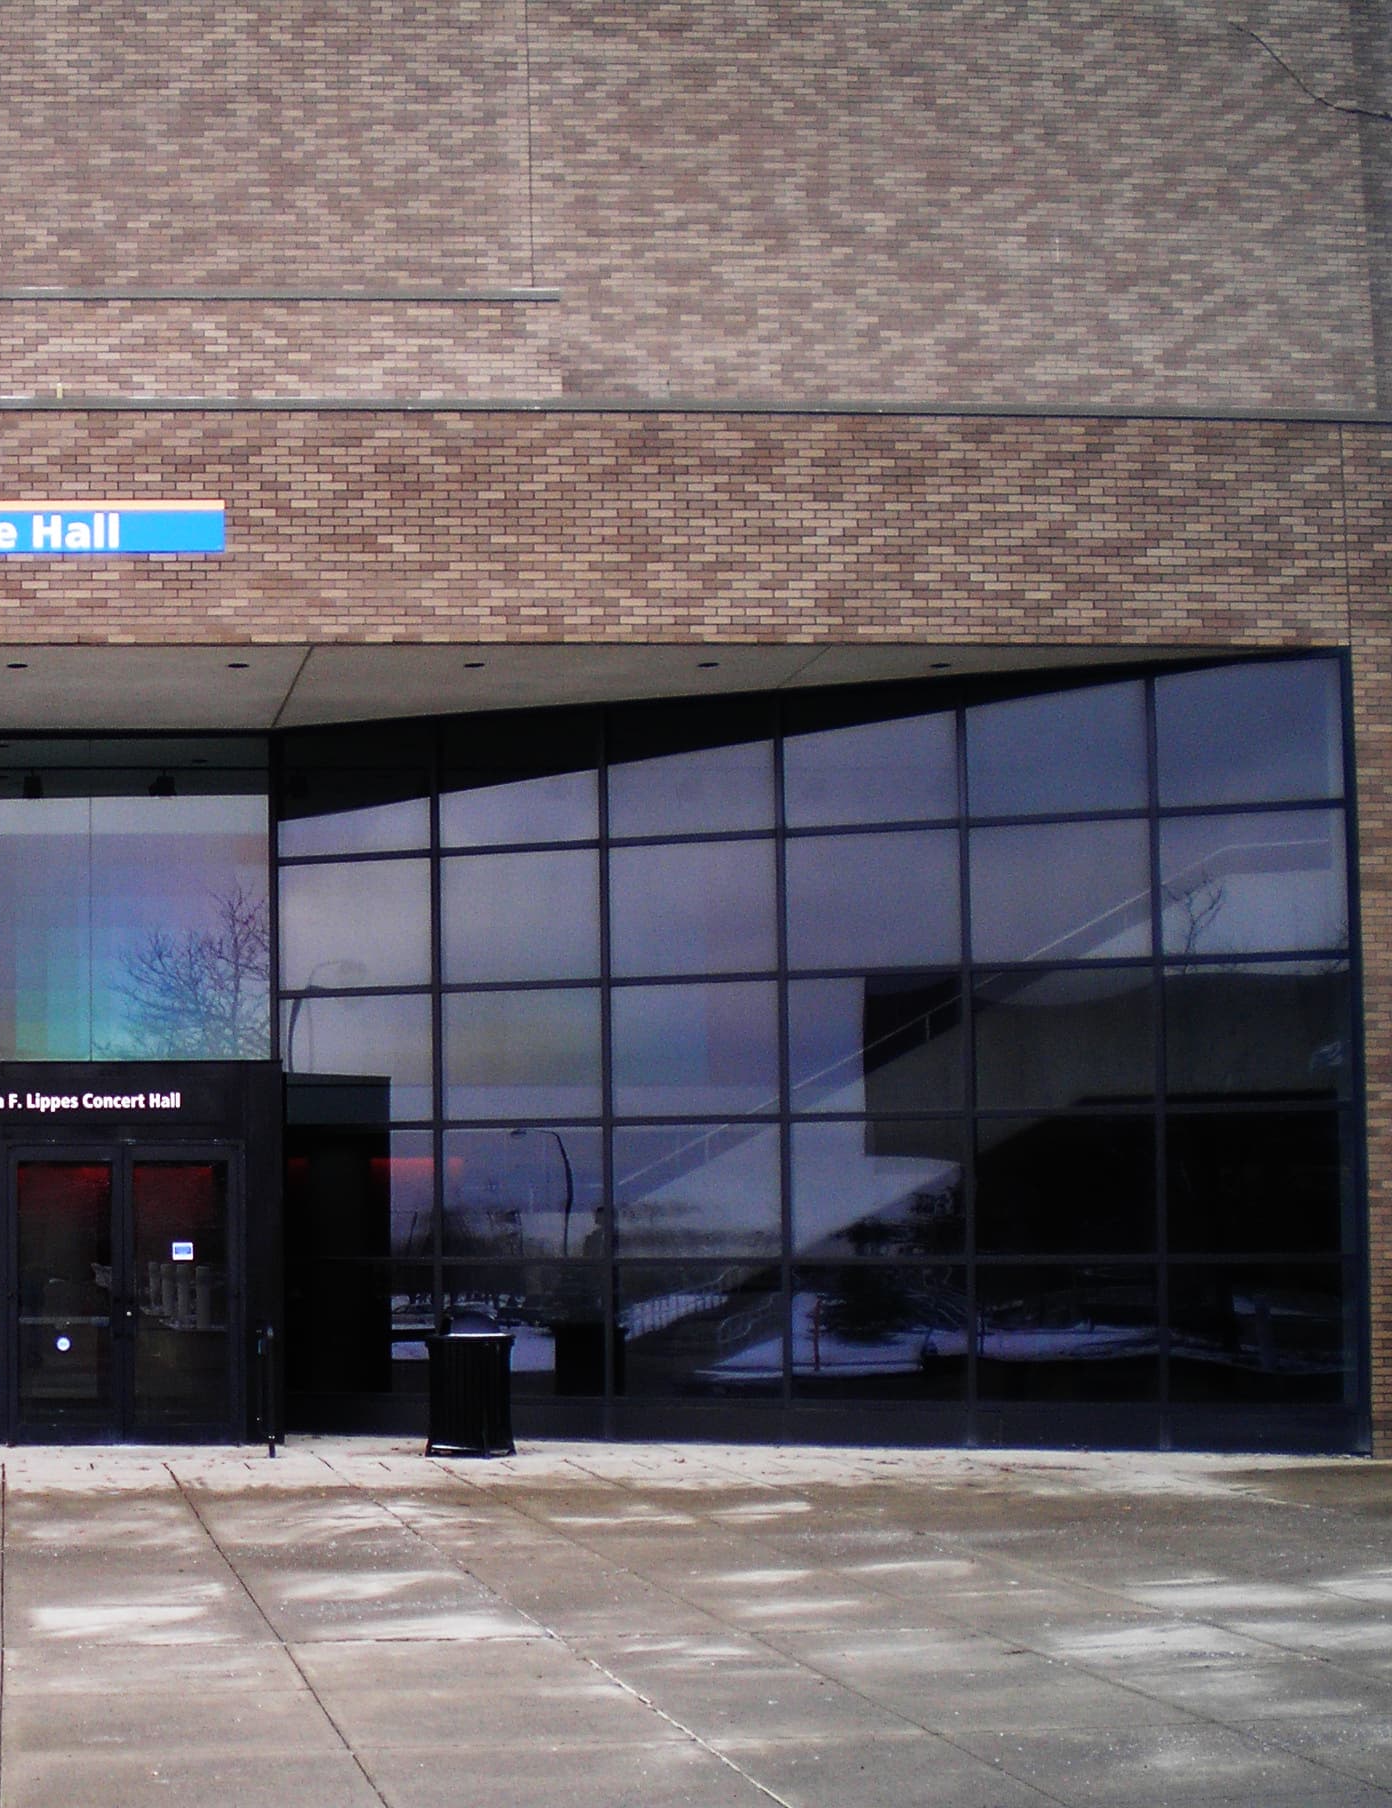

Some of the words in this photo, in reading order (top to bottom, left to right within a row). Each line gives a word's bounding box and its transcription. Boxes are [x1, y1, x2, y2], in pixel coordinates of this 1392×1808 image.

[31, 513, 120, 549] Hall
[8, 1093, 23, 1109] F.
[26, 1092, 79, 1113] Lippes
[82, 1092, 146, 1109] Concert
[149, 1091, 181, 1109] Hall
